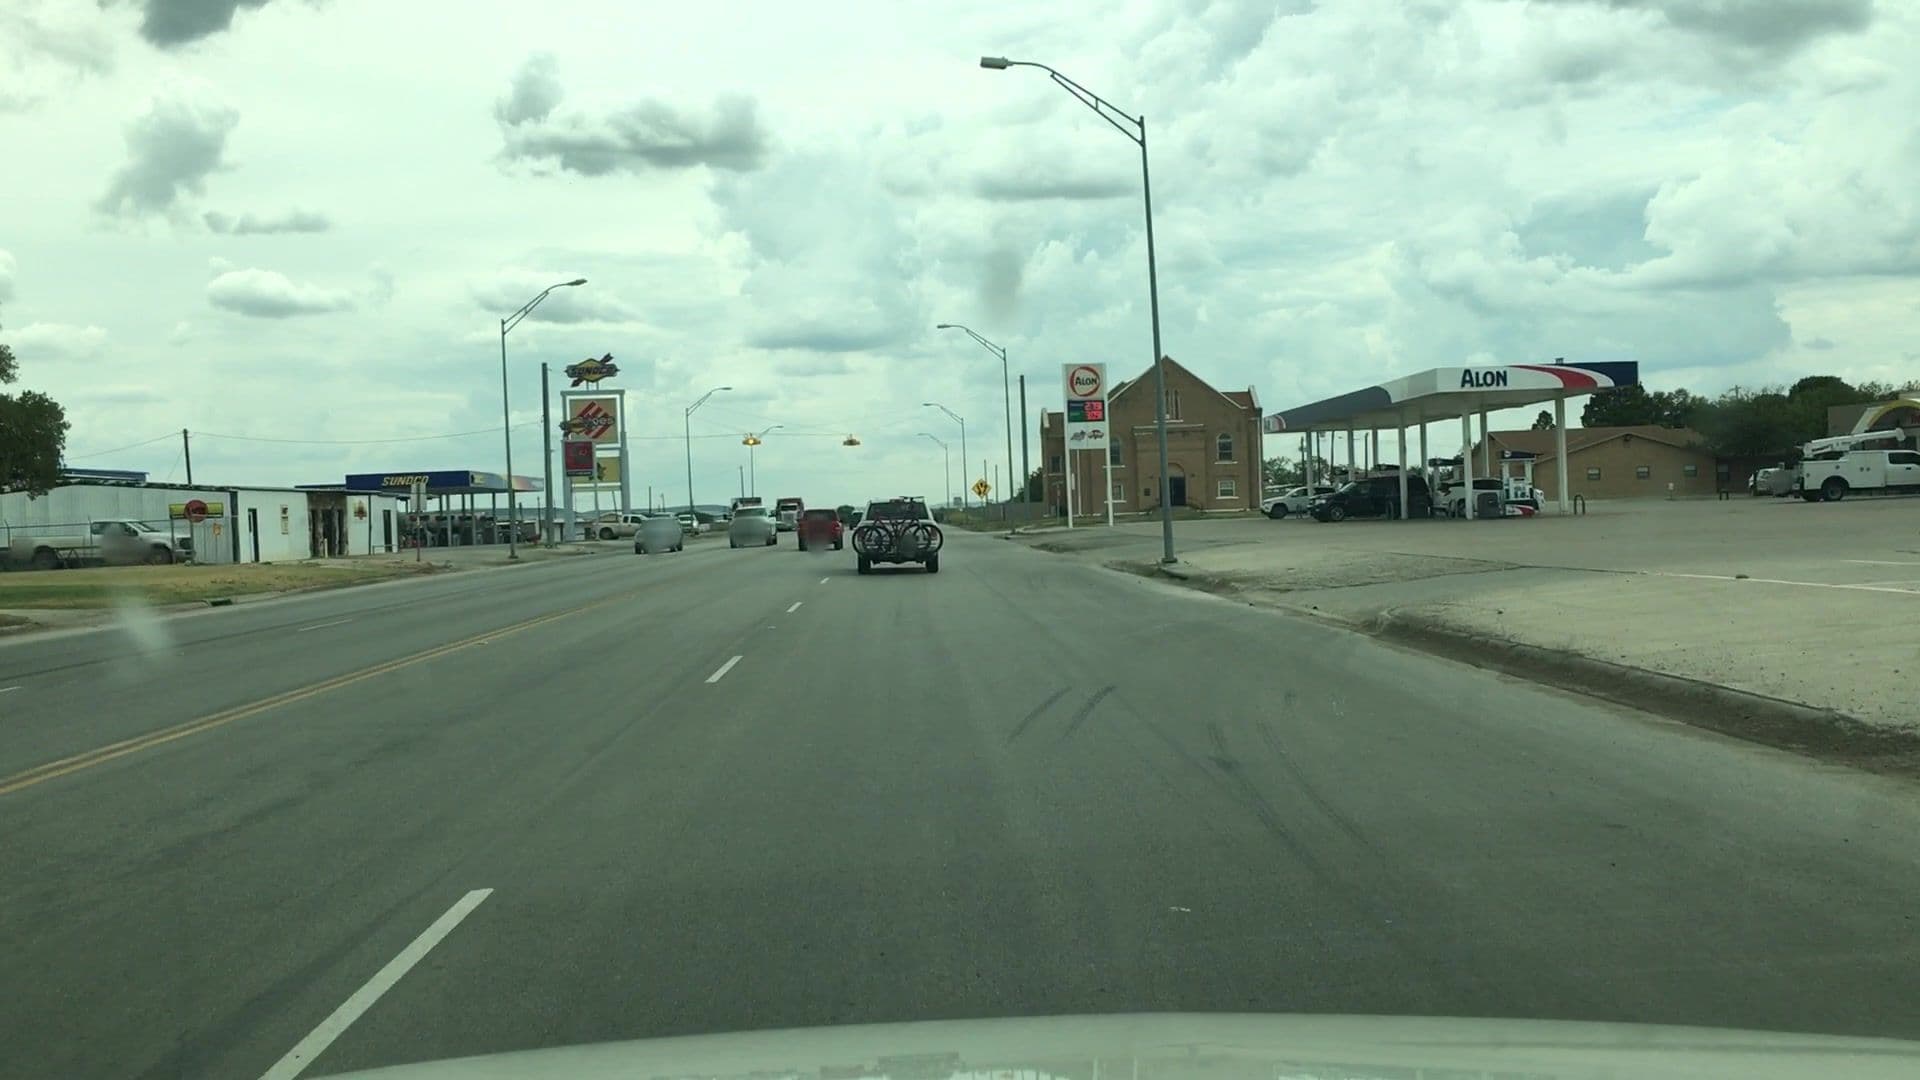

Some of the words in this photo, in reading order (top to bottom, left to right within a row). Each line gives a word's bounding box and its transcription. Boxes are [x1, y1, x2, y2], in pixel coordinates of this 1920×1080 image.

[1075, 376, 1097, 386] ALON
[1461, 369, 1507, 387] ALON
[381, 475, 429, 486] SUNOCO
